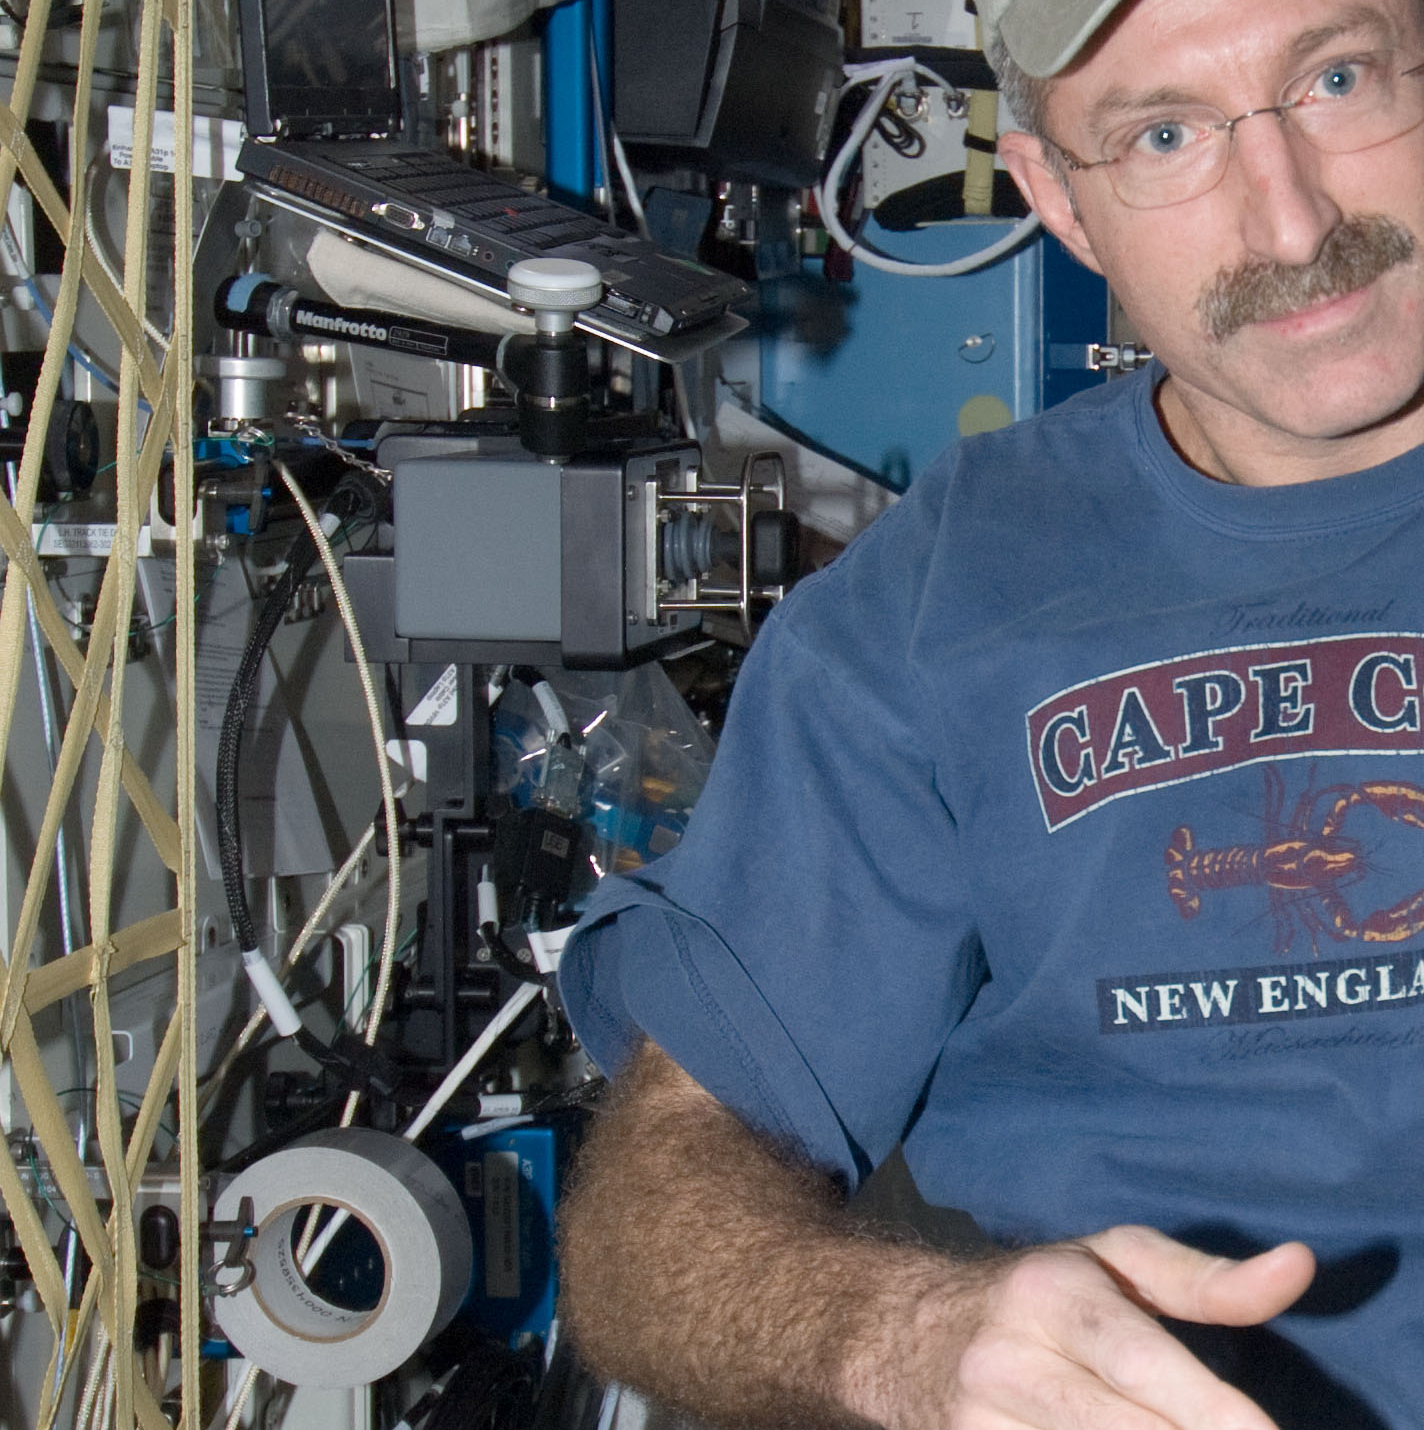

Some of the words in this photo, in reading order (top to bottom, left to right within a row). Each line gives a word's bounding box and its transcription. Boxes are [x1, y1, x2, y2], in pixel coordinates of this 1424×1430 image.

[295, 309, 388, 341] Manfrotto
[1211, 599, 1399, 636] Traditional
[1039, 658, 1315, 798] CAPE
[1110, 980, 1239, 1025] NEW
